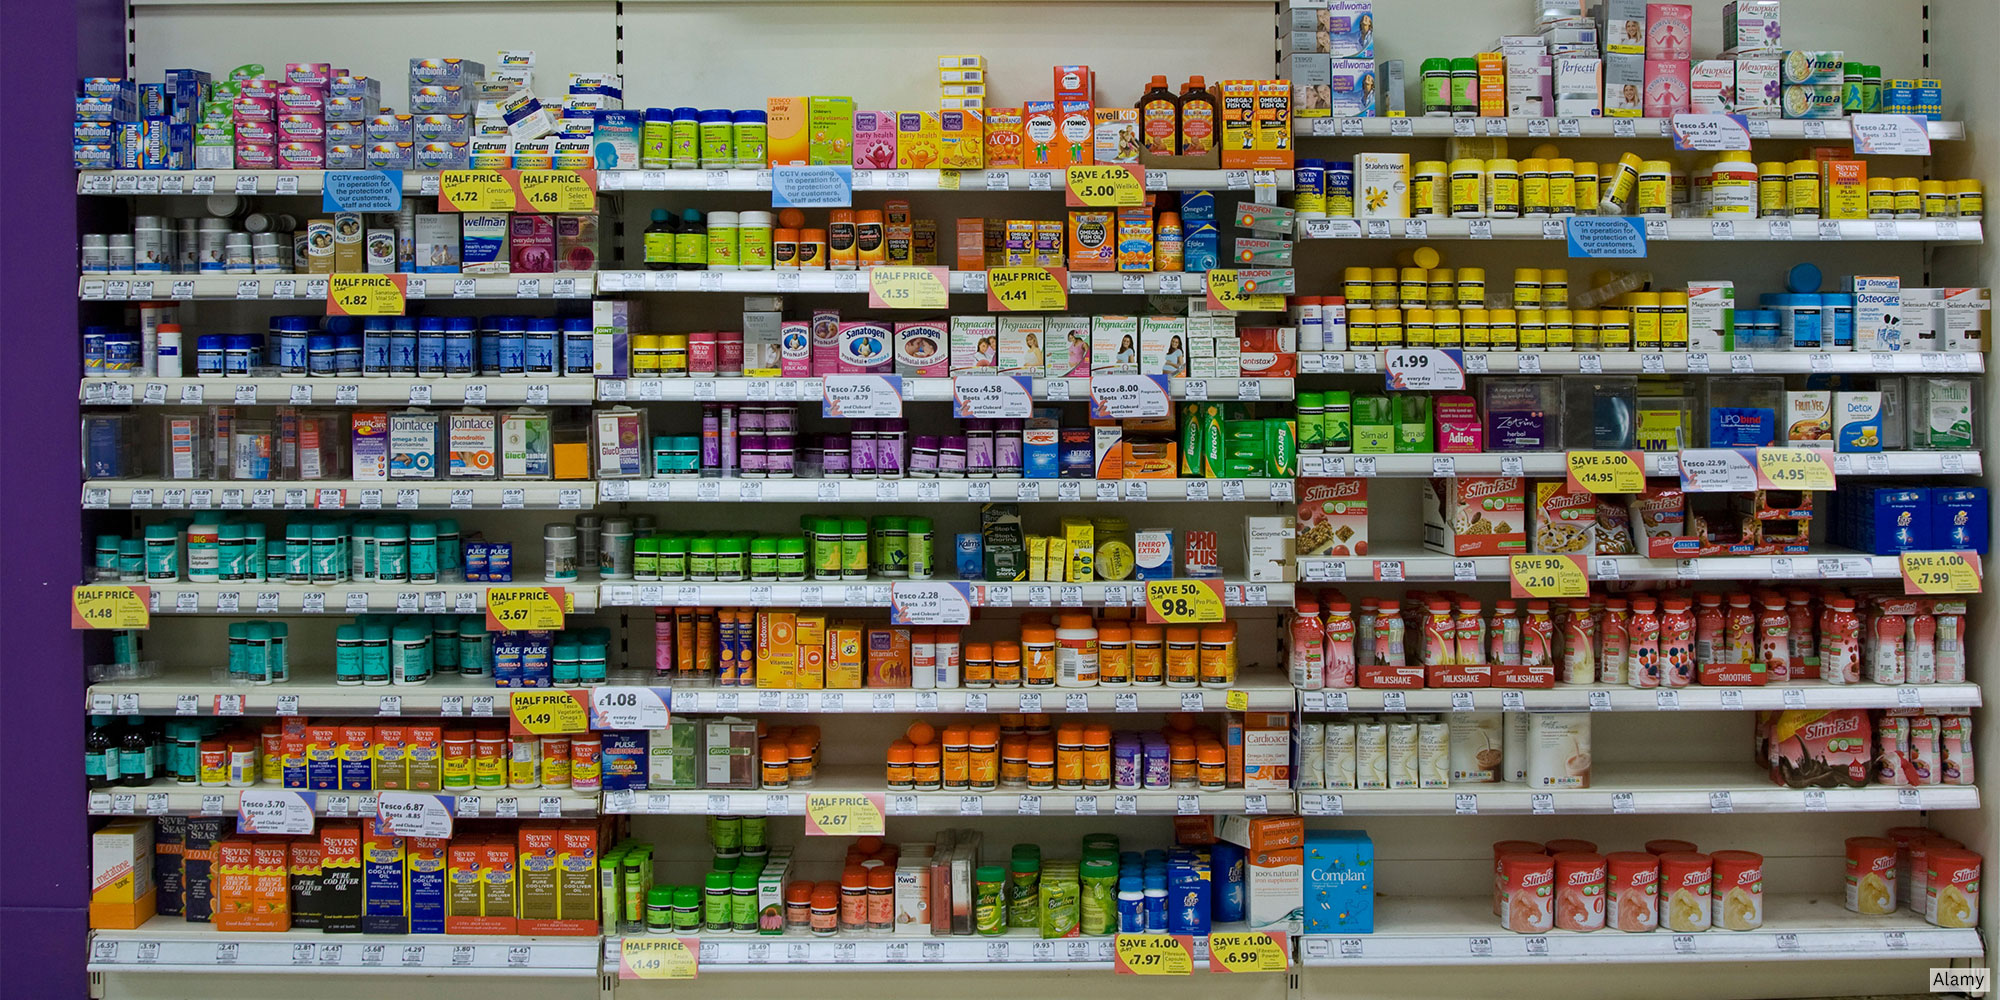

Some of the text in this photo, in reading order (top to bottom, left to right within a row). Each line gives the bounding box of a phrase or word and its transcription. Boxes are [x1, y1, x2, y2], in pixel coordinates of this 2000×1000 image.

[504, 54, 530, 63] Centrum
[1562, 61, 1596, 74] Perfectil
[1807, 58, 1842, 70] Ymea
[1693, 66, 1734, 77] Menopace
[1675, 122, 1718, 130] Tesco £5.41
[473, 142, 506, 152] Centrum
[515, 142, 548, 152] Centrum
[352, 175, 386, 183] recording
[445, 174, 502, 184] HALF PRICE
[523, 175, 580, 184] HALF PRICE
[1071, 170, 1129, 180] SAVE £1.95
[350, 188, 383, 196] protection
[1081, 186, 1114, 197] £5.00
[452, 192, 478, 202] £1.72
[530, 193, 558, 203] £1.68
[1239, 204, 1272, 214] NUROFEN
[464, 218, 506, 228] wellman
[513, 237, 532, 245] everyday
[875, 272, 933, 280] HALF PRICE
[993, 273, 1051, 281] HALF PRICE
[1212, 274, 1238, 282] HALF
[334, 278, 391, 287] HALF PRICE
[882, 289, 909, 299] £1.35
[1001, 290, 1027, 300] £1.41
[1858, 294, 1900, 304] Osteocare
[340, 295, 367, 305] £1.82
[953, 318, 996, 330] Pregnacare
[846, 327, 886, 339] Sanatogen
[1242, 356, 1271, 364] antistax
[1392, 355, 1428, 369] £1.99
[850, 385, 870, 393] £7.56
[980, 385, 1002, 393] £4.58
[1117, 385, 1138, 393] £8.00
[1847, 403, 1873, 413] Detox
[391, 416, 433, 432] Jointace
[1210, 426, 1218, 460] Berocca
[1449, 433, 1474, 444] Adios
[1277, 429, 1286, 466] Berocca
[1572, 456, 1628, 465] SAVE £5.00
[1762, 453, 1821, 463] SAVE £3.00
[1582, 473, 1614, 483] £14.95
[1772, 469, 1804, 481] £4.95
[959, 540, 980, 549] Kalms
[1186, 531, 1217, 550] PRO
[1186, 550, 1217, 565] PLUS
[1906, 556, 1964, 566] SAVE £1.00
[1515, 560, 1564, 570] SAVE 90p
[1525, 576, 1555, 587] £2.10
[1918, 573, 1949, 584] £7.99
[1151, 585, 1201, 596] SAVE 50p
[78, 592, 103, 600] HALF
[492, 591, 549, 601] HALF PRICE
[894, 592, 938, 600] Tesco £2.28
[1162, 599, 1195, 617] 98p
[85, 608, 112, 619] £1.48
[499, 609, 528, 620] £3.67
[496, 647, 520, 655] PULSE
[1374, 676, 1412, 685] MILKSHAKE
[1719, 674, 1752, 682] SMOOTHIE
[515, 695, 572, 705] HALF PRICE
[599, 694, 637, 707] £1.08
[523, 714, 550, 724] £1.49
[1247, 733, 1288, 744] Cardioace
[265, 800, 285, 808] £3.70
[811, 797, 869, 806] HALF PRICE
[819, 815, 848, 826] £2.67
[526, 834, 552, 842] SEVEN
[222, 847, 251, 856] SEVEN
[226, 855, 249, 864] SEAS
[1268, 855, 1297, 864] spatone
[96, 859, 131, 885] metatone
[1312, 870, 1366, 882] Complan
[115, 877, 130, 890] tonic
[898, 876, 916, 884] Kwai
[626, 942, 683, 950] HALF PRICE
[1120, 938, 1179, 949] SAVE £1.00
[1213, 936, 1272, 946] SAVE £1.00
[1129, 954, 1160, 966] £7.97
[1224, 952, 1257, 964] £6.99
[632, 960, 660, 969] £1.49
